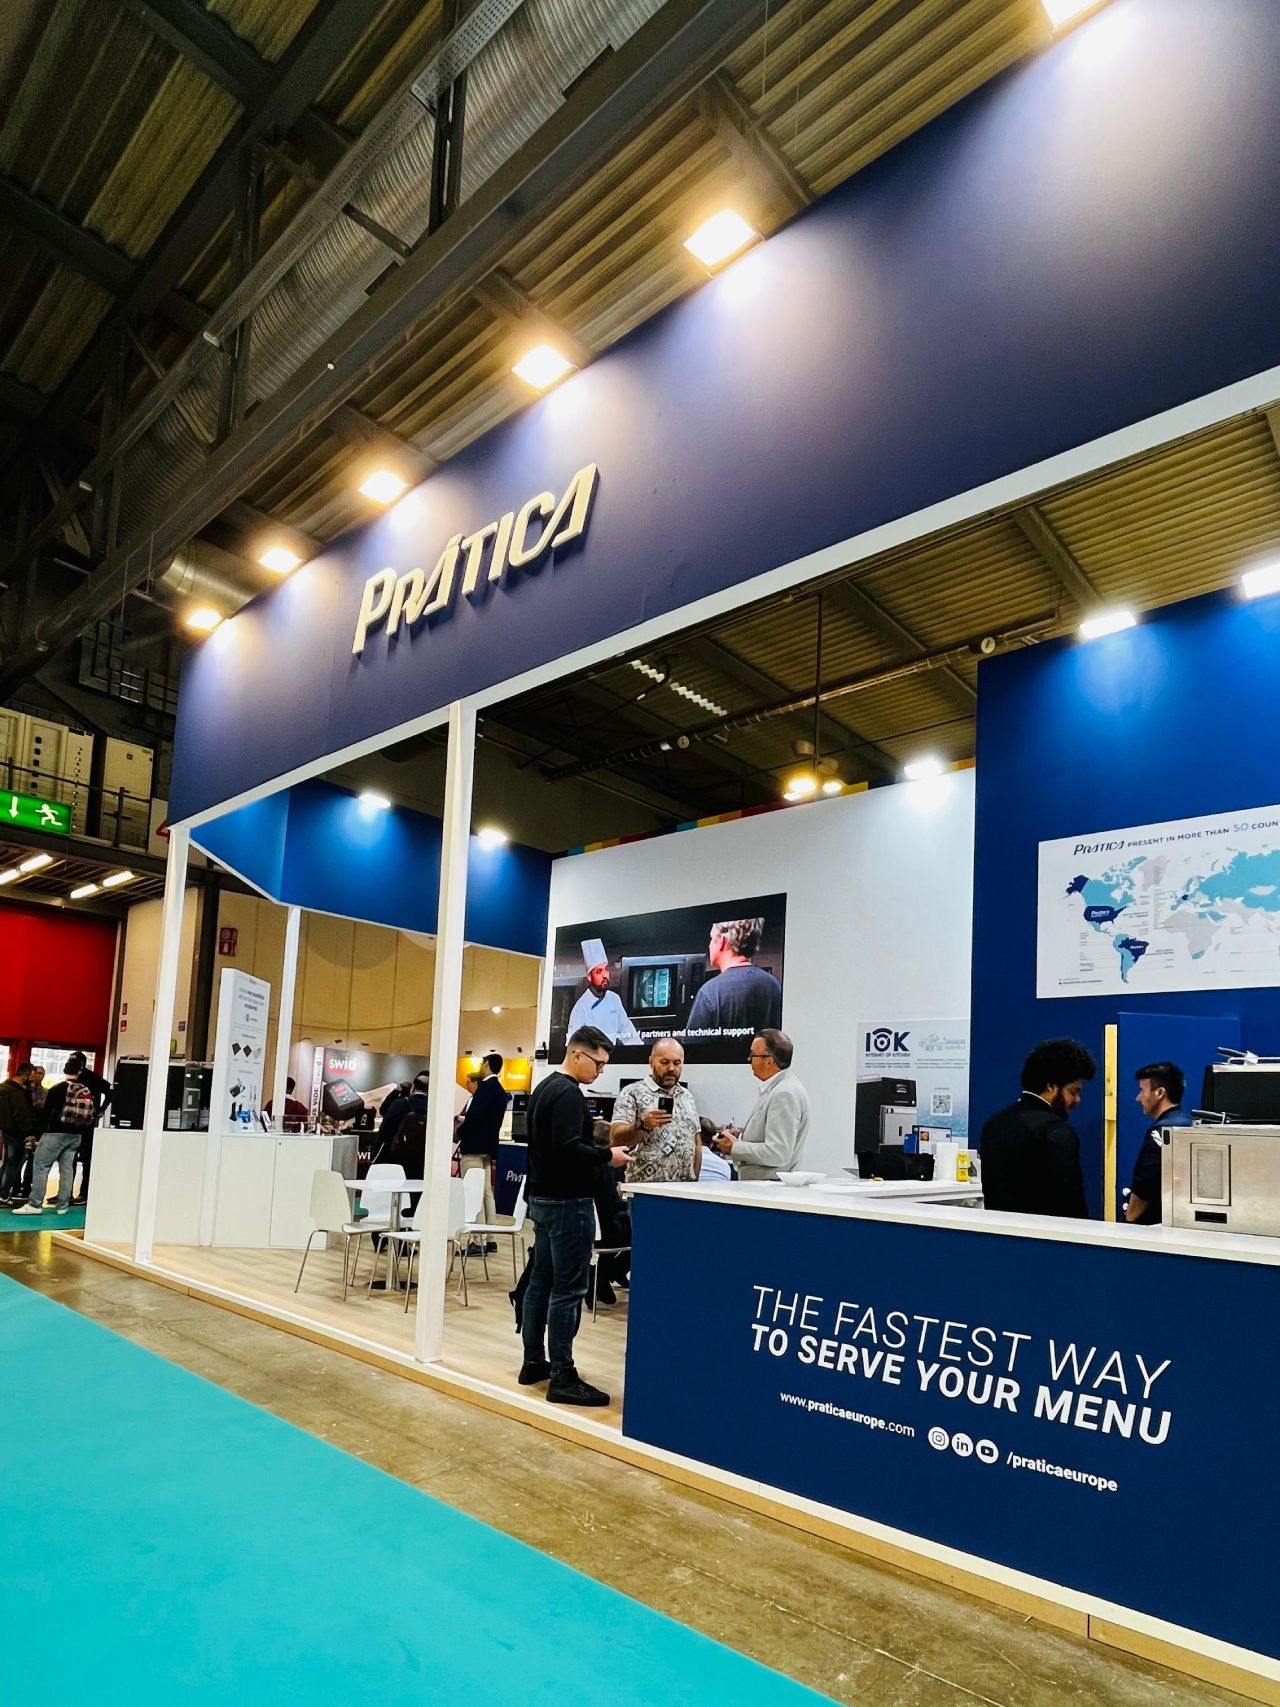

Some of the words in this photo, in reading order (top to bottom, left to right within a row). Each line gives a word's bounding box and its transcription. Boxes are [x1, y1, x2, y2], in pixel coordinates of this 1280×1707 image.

[352, 463, 600, 655] PRÁTICA
[1128, 838, 1163, 848] PRESENT
[1178, 832, 1202, 841] MORE
[1205, 828, 1230, 837] THAN
[1233, 823, 1249, 833] 50
[1251, 820, 1280, 830] COUN
[633, 1030, 641, 1038] of
[641, 1029, 671, 1039] partners
[672, 1028, 686, 1037] and
[687, 1026, 722, 1037] technical
[722, 1026, 755, 1038] support
[865, 1027, 911, 1052] IOK
[357, 1151, 371, 1160] wi
[753, 1285, 824, 1332] THE
[834, 1302, 1032, 1372] FASTEST
[1050, 1340, 1172, 1399] WAY
[751, 1324, 789, 1357] TO
[797, 1335, 906, 1386] SERVE
[916, 1360, 1021, 1413] YOUR
[1034, 1385, 1172, 1445] MENU
[780, 1392, 915, 1438] www.praticaeurope.com
[1006, 1451, 1118, 1492] /praticaeurope
